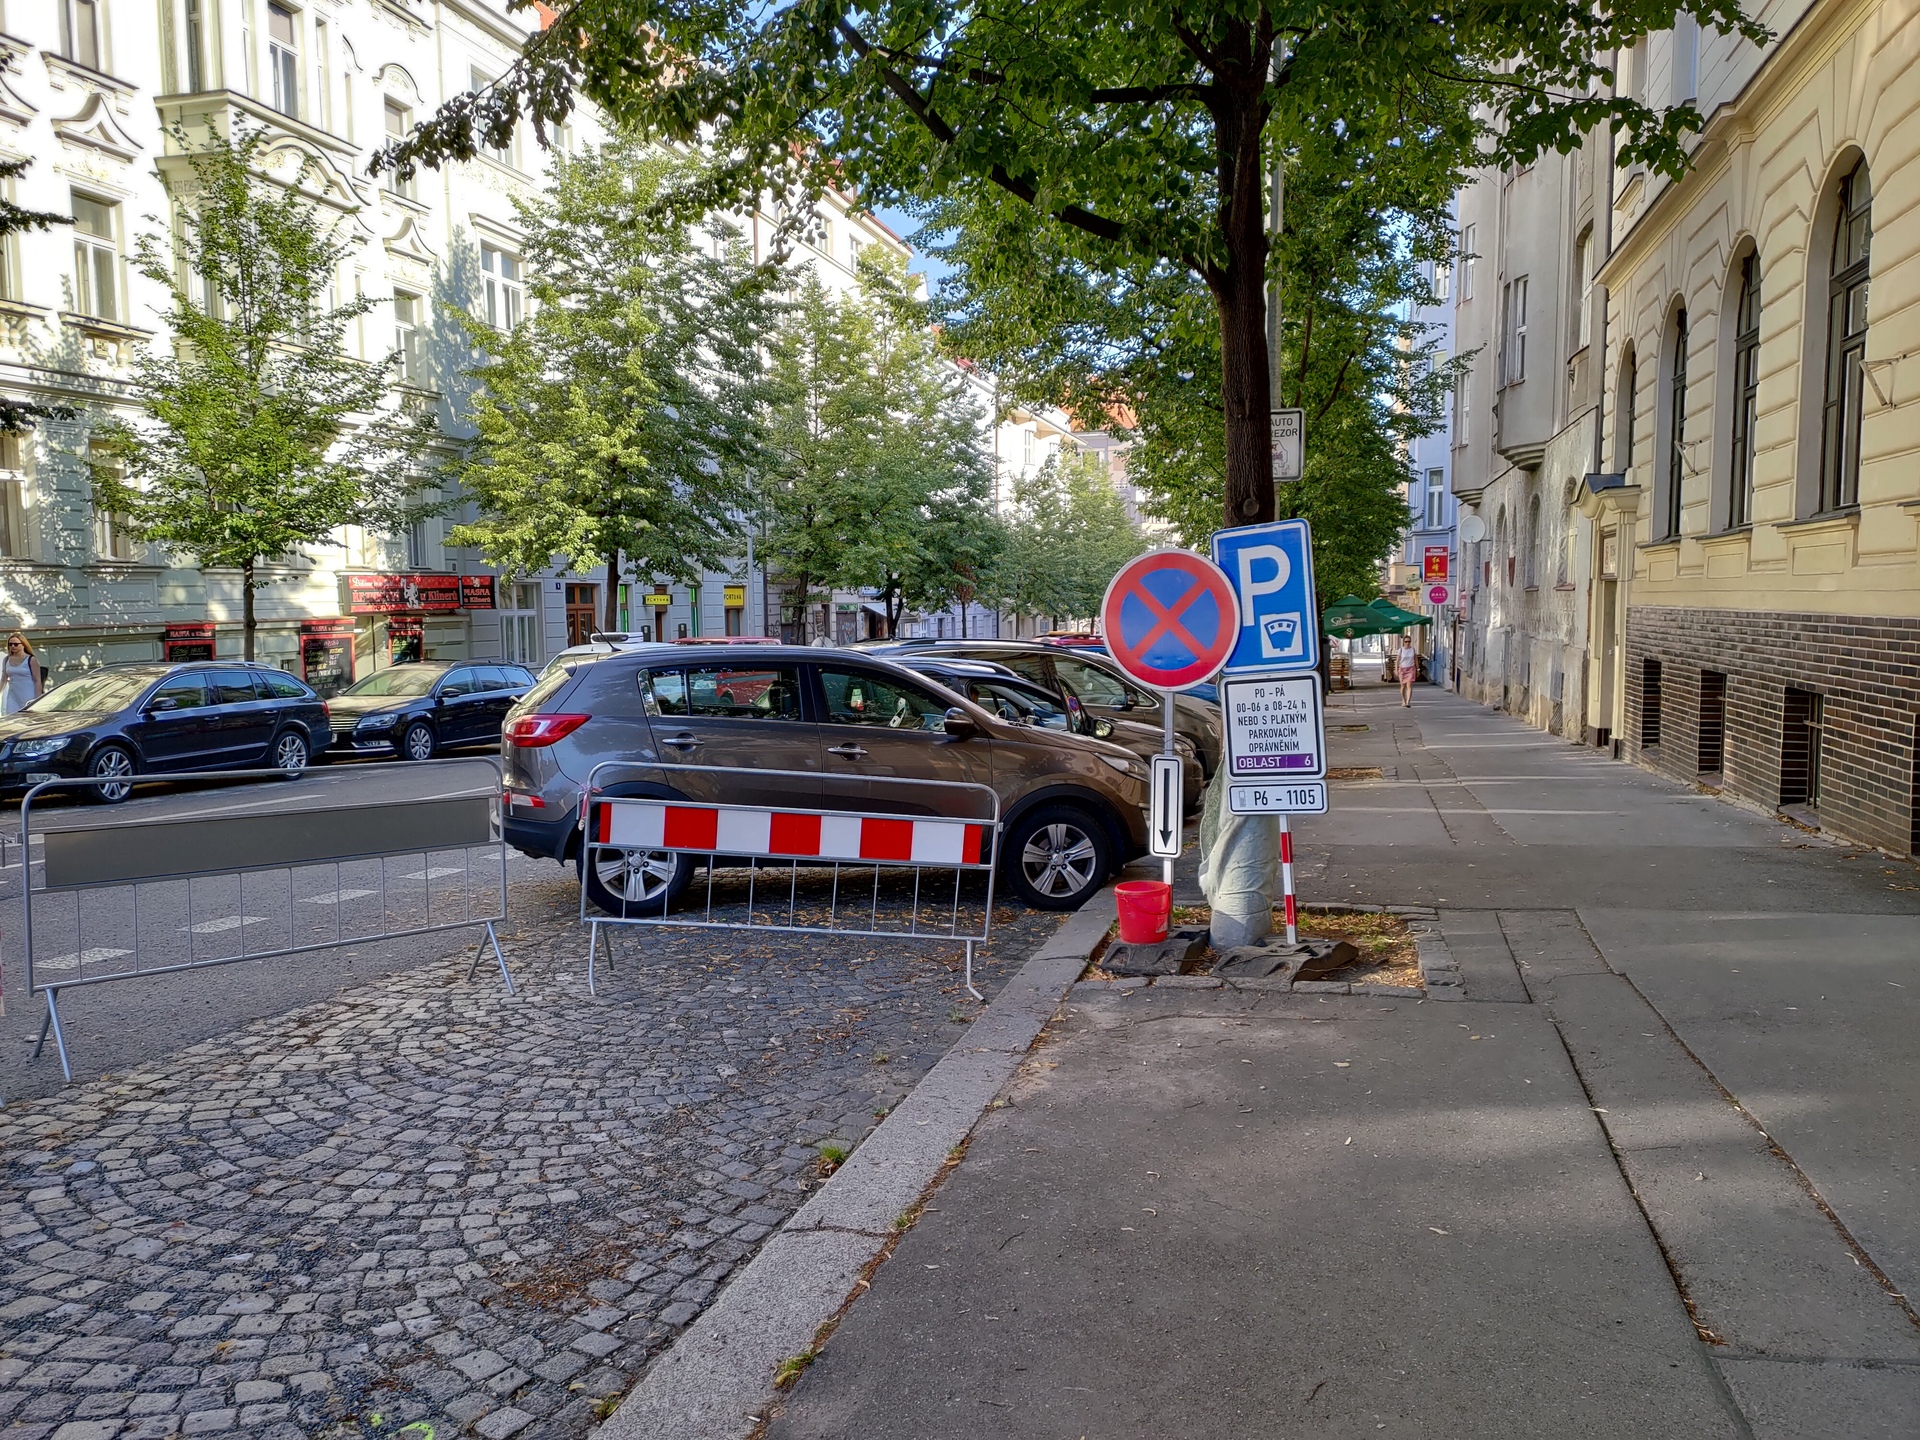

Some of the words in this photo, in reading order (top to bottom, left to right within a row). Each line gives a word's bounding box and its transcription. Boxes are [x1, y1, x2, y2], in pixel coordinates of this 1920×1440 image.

[1271, 428, 1298, 437] EZOR
[1238, 544, 1291, 627] P
[1255, 688, 1265, 698] PO
[1275, 684, 1285, 697] PÁ
[1236, 702, 1261, 713] 00-06
[1272, 700, 1298, 711] 08-24
[1301, 699, 1307, 709] h
[1238, 715, 1259, 727] NEBO
[1262, 715, 1267, 725] S
[1271, 711, 1307, 725] PLATNÝM
[1249, 725, 1298, 739] PARKOVACÍM
[1249, 739, 1300, 753] OPRÁVNĚNÍM
[1239, 756, 1281, 768] OBLAST
[1304, 755, 1311, 766] 6
[1254, 790, 1268, 806] P6
[1286, 789, 1316, 806] 1105
